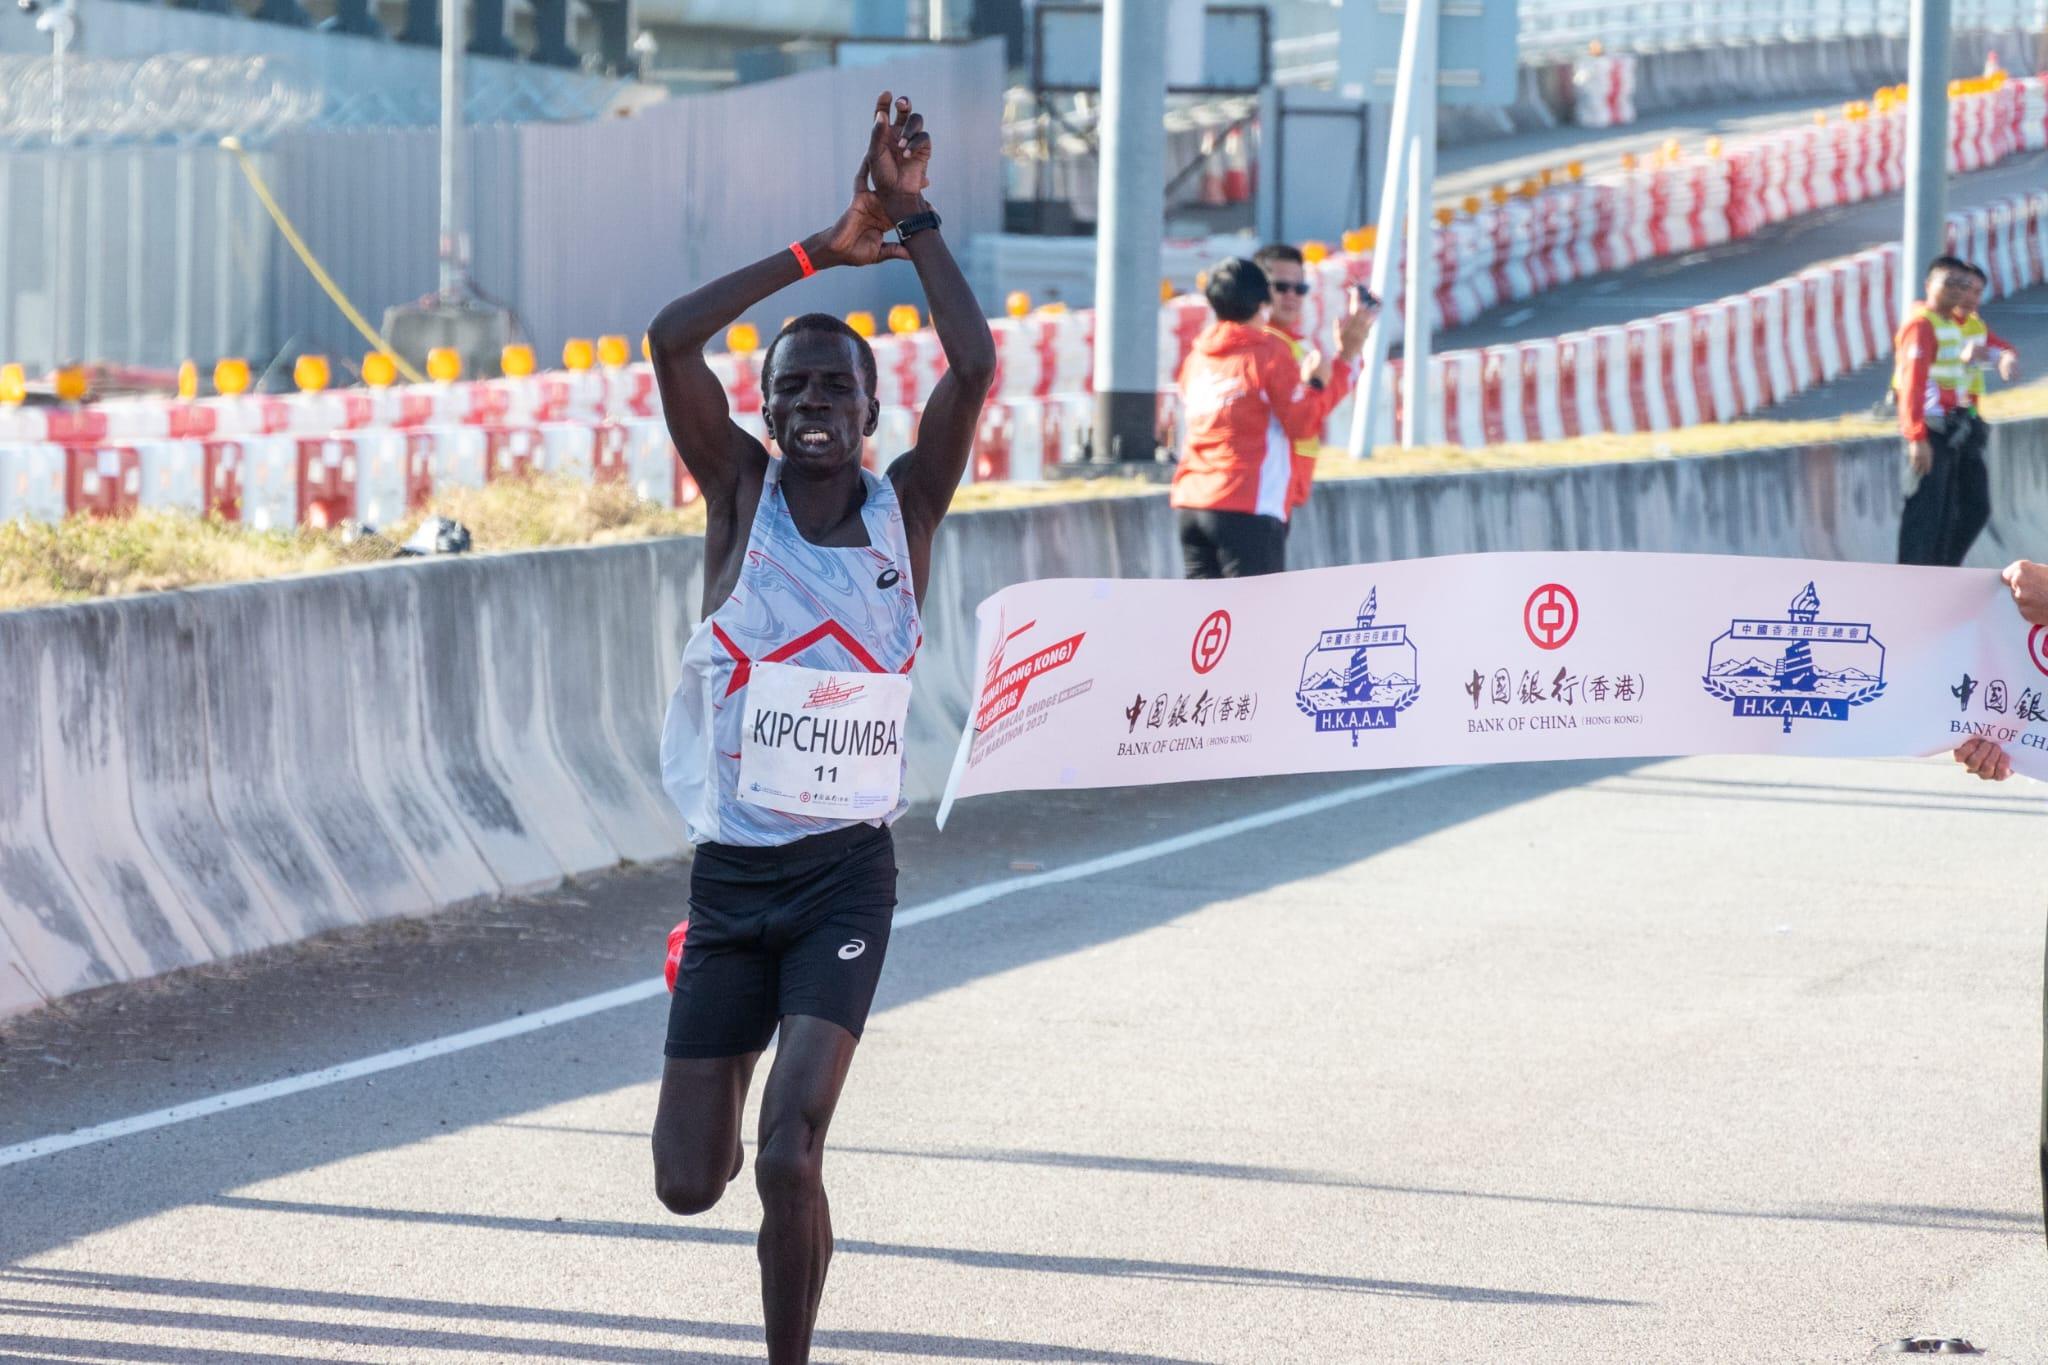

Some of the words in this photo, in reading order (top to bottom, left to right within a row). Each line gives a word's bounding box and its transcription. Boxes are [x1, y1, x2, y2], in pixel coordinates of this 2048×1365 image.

[1741, 623, 1860, 640] 中國香港田徑總會
[1000, 662, 1033, 694] (HONG
[1033, 641, 1073, 673] KONG)
[1743, 698, 1838, 718] H.K.A.A.A.
[1322, 710, 1389, 729] H.K.A.A.A.
[1468, 718, 1504, 733] BANK
[1508, 717, 1526, 730] OF
[1529, 714, 1577, 730] CHINA
[1582, 716, 1611, 727] (HONG
[1613, 714, 1644, 725] KONG)
[753, 708, 898, 757] KIPCHUMBA
[1950, 720, 1996, 738] BANK
[1997, 727, 2018, 742] OF
[2020, 733, 2048, 752] CH
[1117, 741, 1151, 756] BANK
[1152, 740, 1168, 753] OF
[1168, 736, 1204, 752] CHINA
[814, 765, 838, 783] 11
